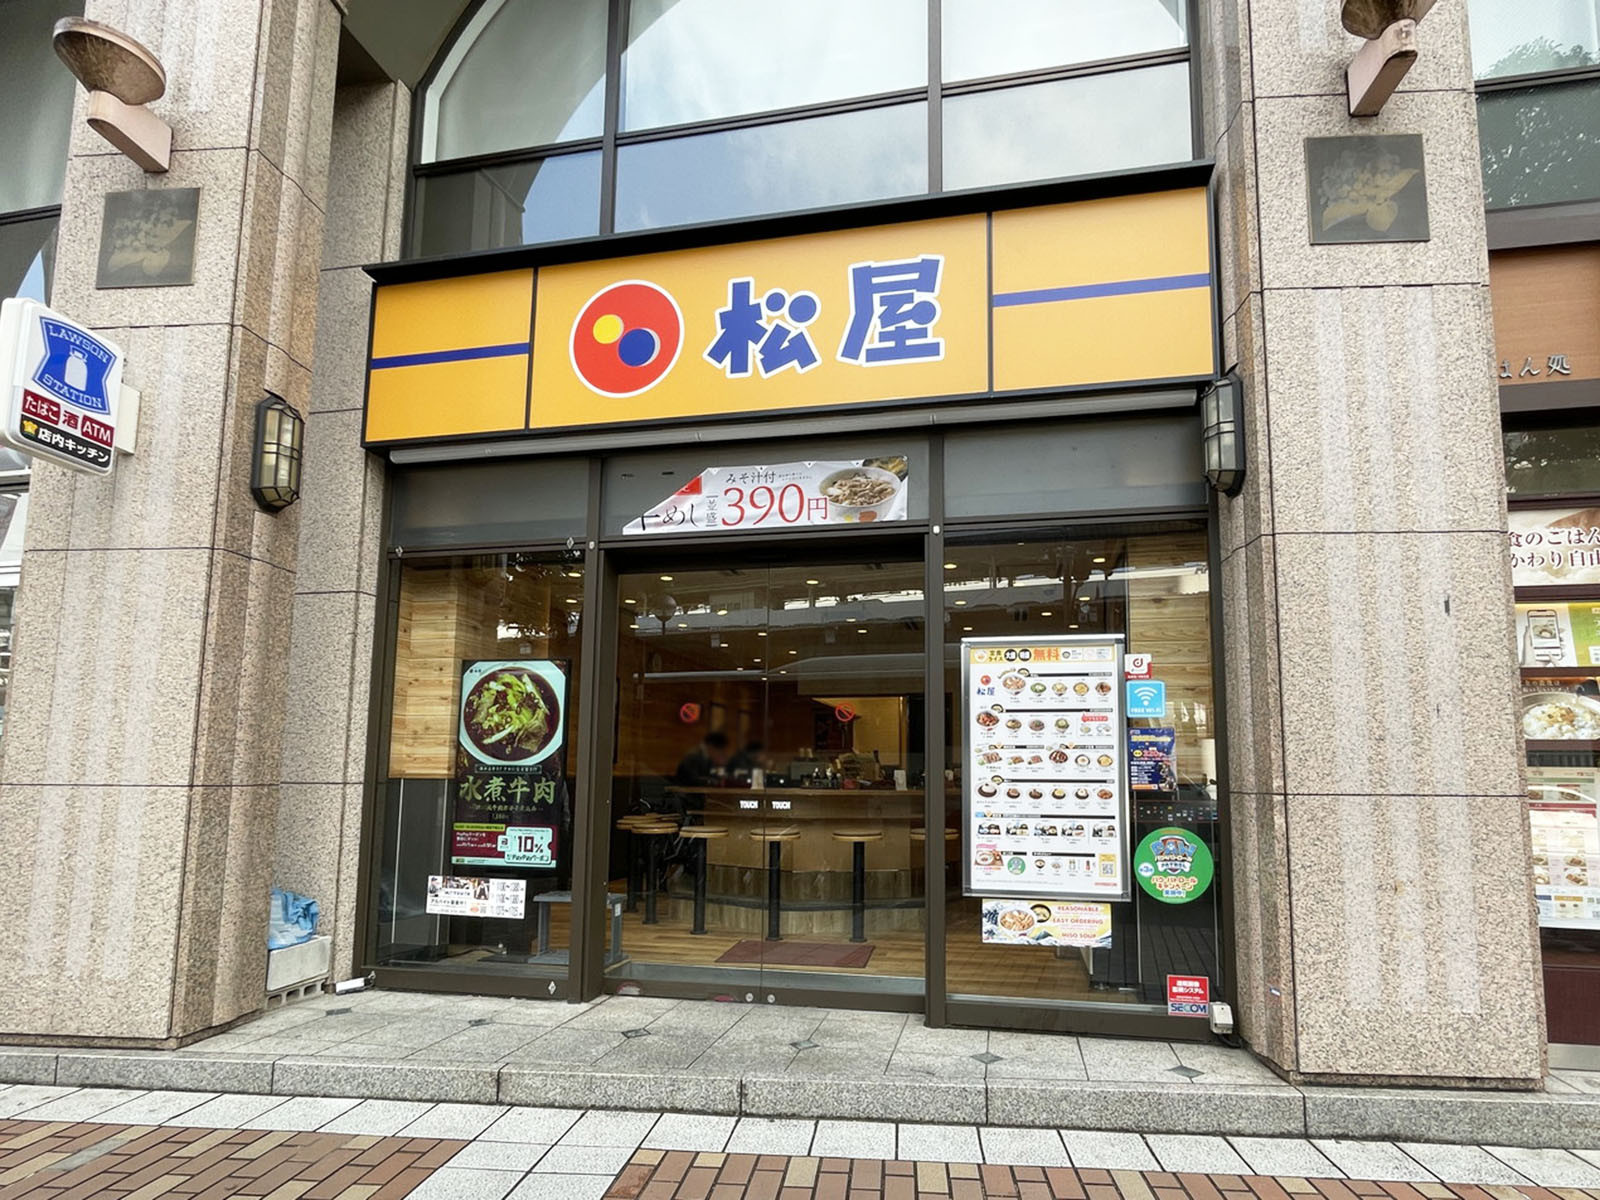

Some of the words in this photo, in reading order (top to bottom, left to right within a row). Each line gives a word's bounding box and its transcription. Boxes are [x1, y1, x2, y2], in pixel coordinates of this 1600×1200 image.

[704, 254, 944, 378] 松屋
[48, 325, 109, 364] LAWSON
[42, 373, 103, 408] STATION
[25, 395, 59, 418] たばこ
[62, 409, 79, 430] 酒
[83, 420, 111, 443] ATM
[38, 427, 109, 463] 店内キッチン
[725, 471, 776, 485] みそ汁付
[641, 503, 699, 531] めし
[721, 483, 829, 527] 390円
[977, 687, 996, 696] 松屋
[460, 775, 556, 804] 水煮牛肉
[740, 800, 758, 809] TOUCH
[772, 801, 791, 809] TOUCH
[518, 836, 543, 853] 10%
[1171, 1003, 1207, 1013] SECOM
